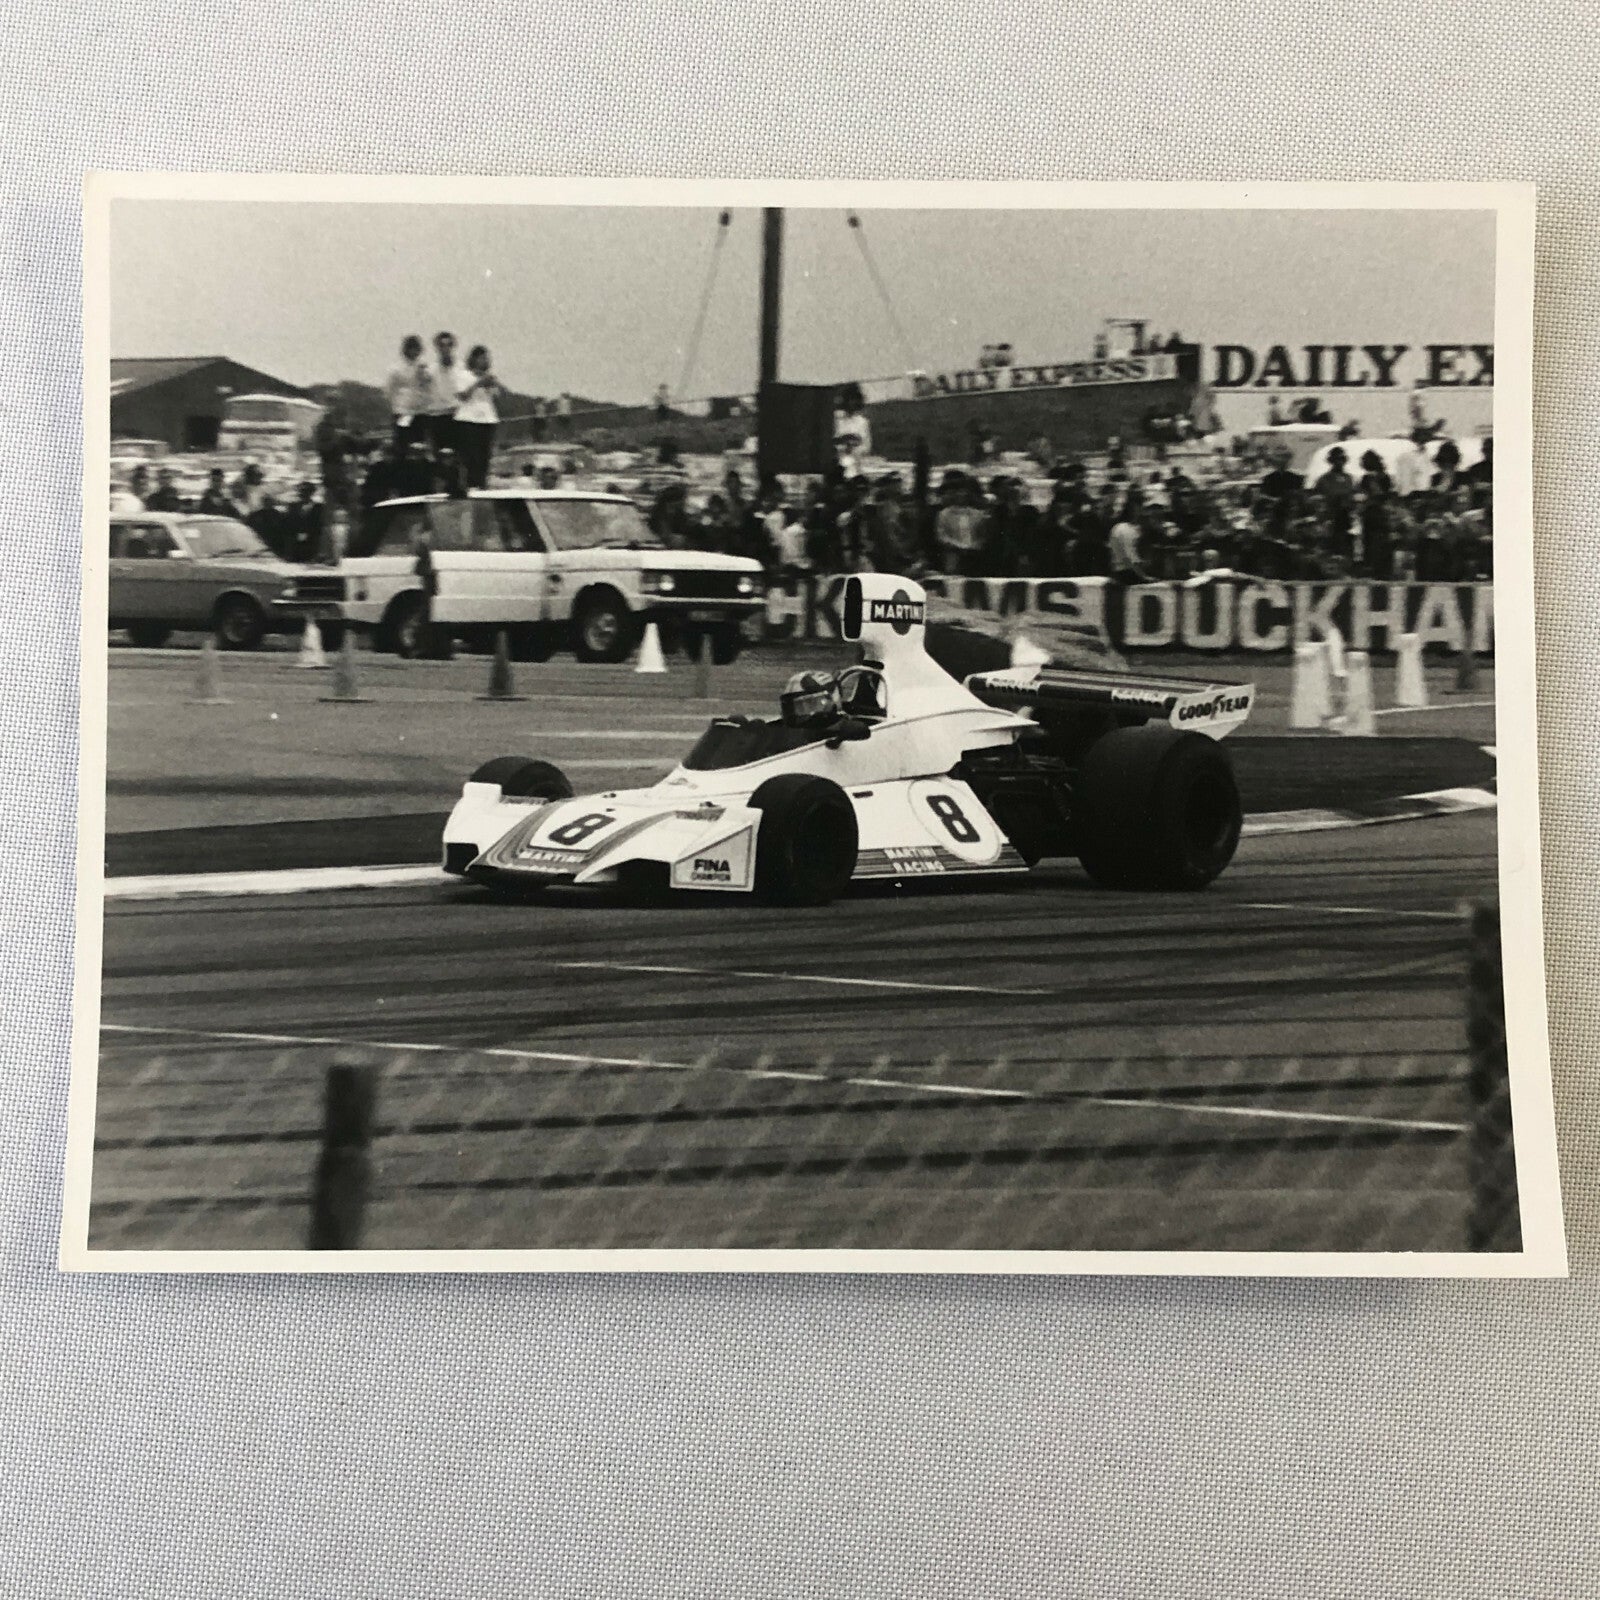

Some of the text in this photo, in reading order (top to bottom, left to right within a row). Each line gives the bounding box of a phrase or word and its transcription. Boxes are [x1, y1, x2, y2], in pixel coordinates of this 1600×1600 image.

[1211, 344, 1408, 389] DAILY
[1178, 694, 1250, 721] GOODYEAR
[548, 813, 616, 846] 8
[926, 794, 981, 843] 8
[694, 858, 731, 872] FINA
[893, 860, 946, 874] RACING
